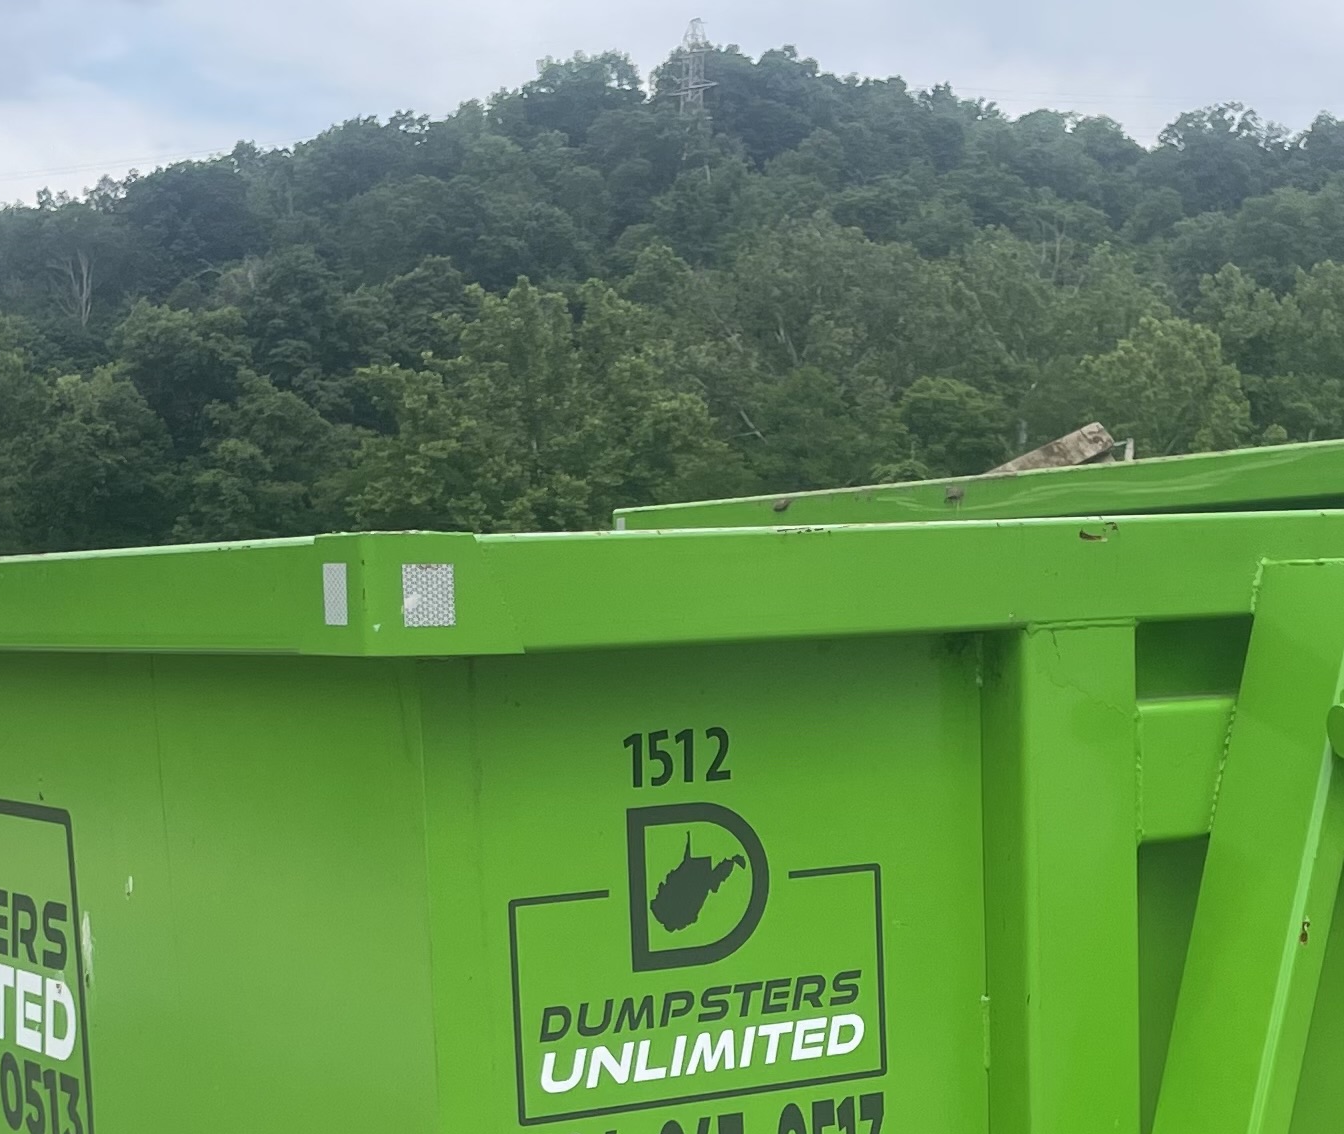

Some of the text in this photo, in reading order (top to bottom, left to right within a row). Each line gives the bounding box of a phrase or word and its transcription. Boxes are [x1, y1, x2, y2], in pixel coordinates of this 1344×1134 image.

[623, 726, 732, 788] 1512
[539, 969, 862, 1042] DUMPSTERS
[539, 1013, 866, 1094] UNLIMITED
